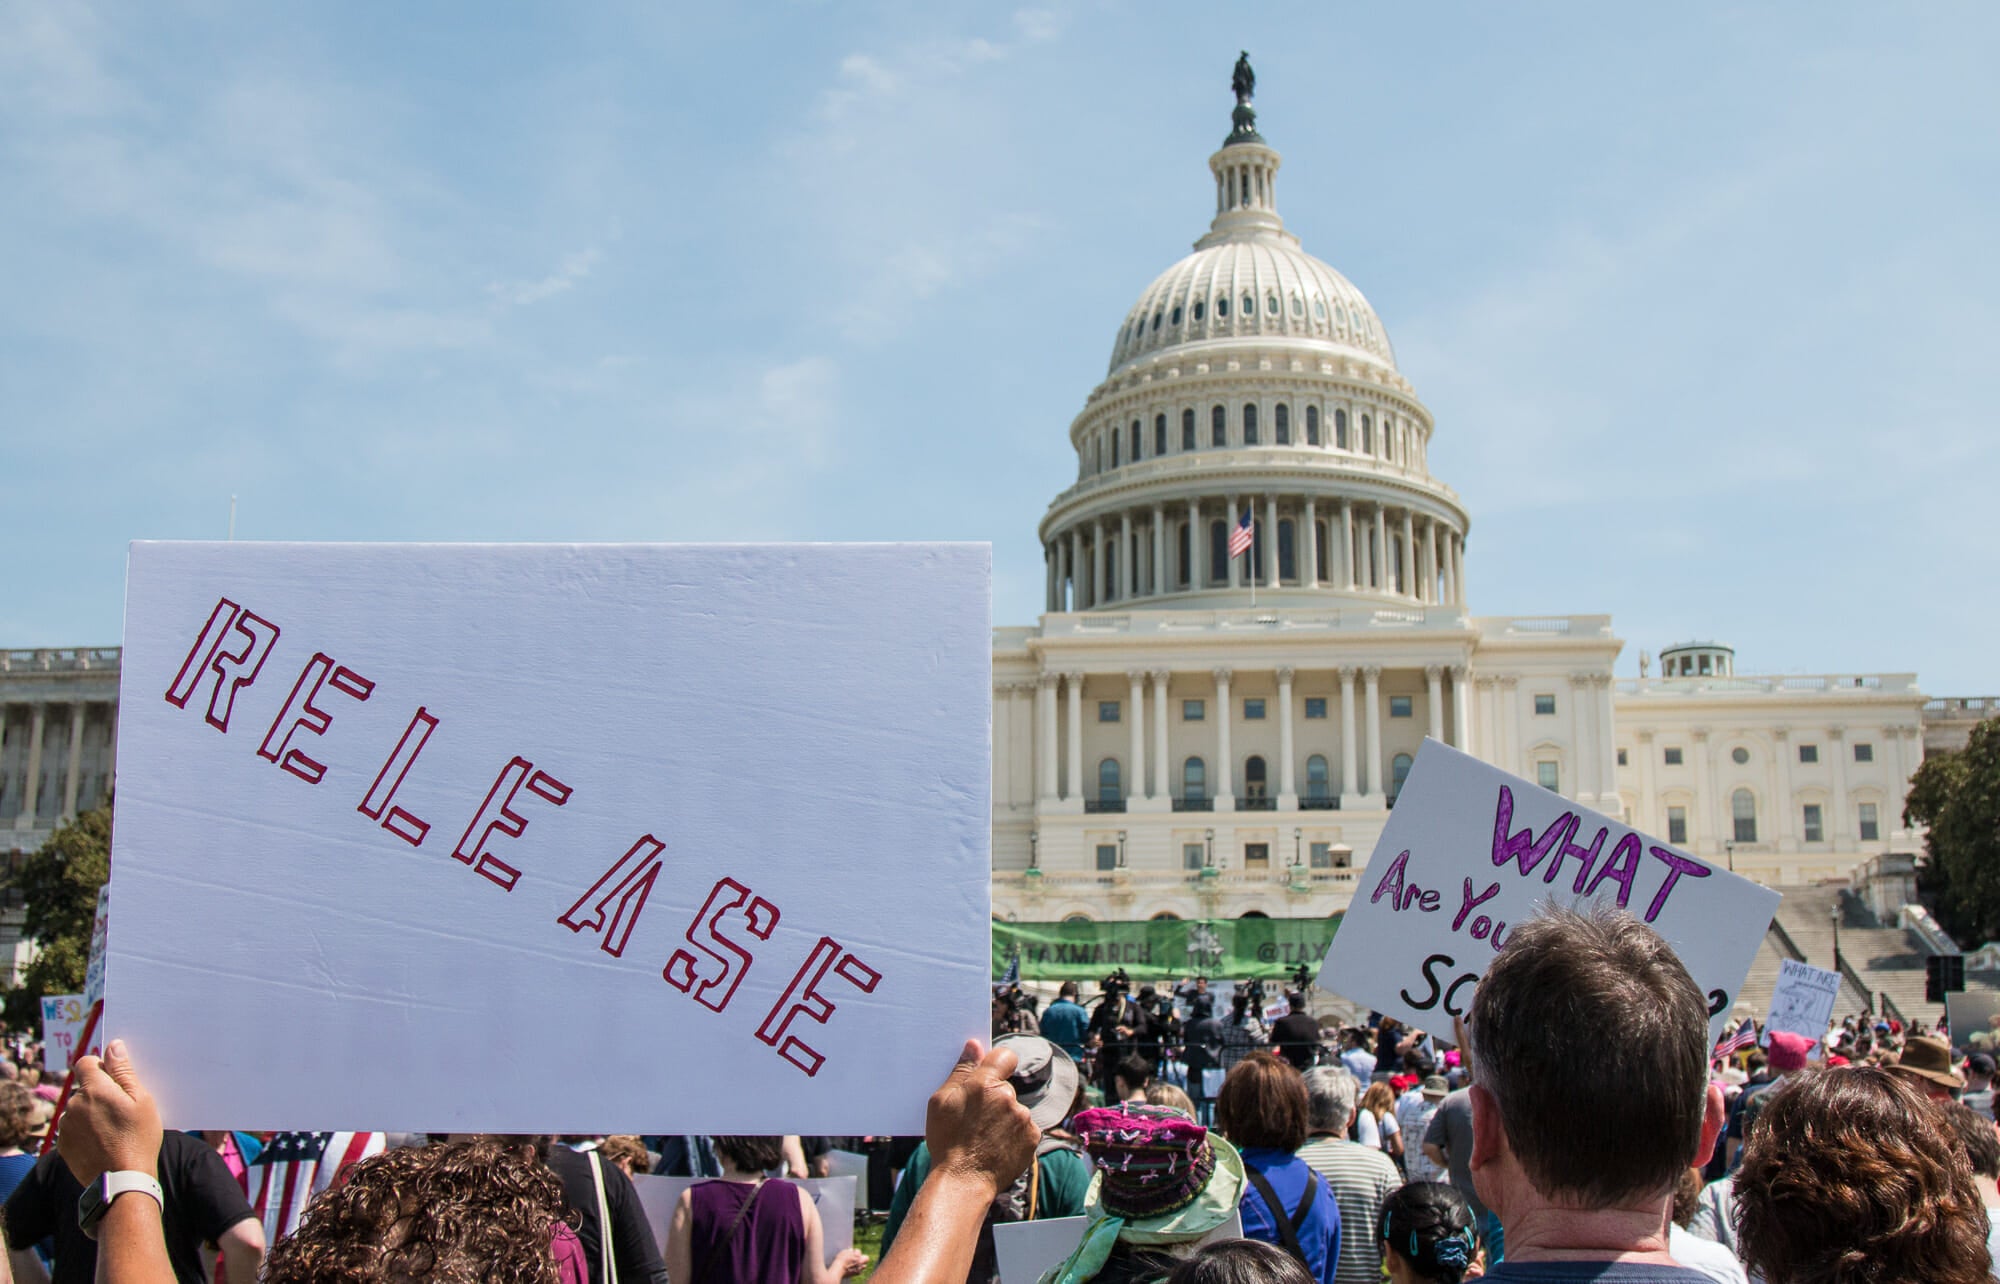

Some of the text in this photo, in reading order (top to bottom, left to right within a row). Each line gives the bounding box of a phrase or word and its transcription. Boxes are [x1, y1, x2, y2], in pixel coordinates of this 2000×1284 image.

[165, 598, 882, 1077] RELEASE
[1492, 784, 1712, 923] WHAT
[1371, 849, 1441, 912] Are
[1783, 961, 1815, 981] WHAT
[53, 1032, 72, 1049] TO
